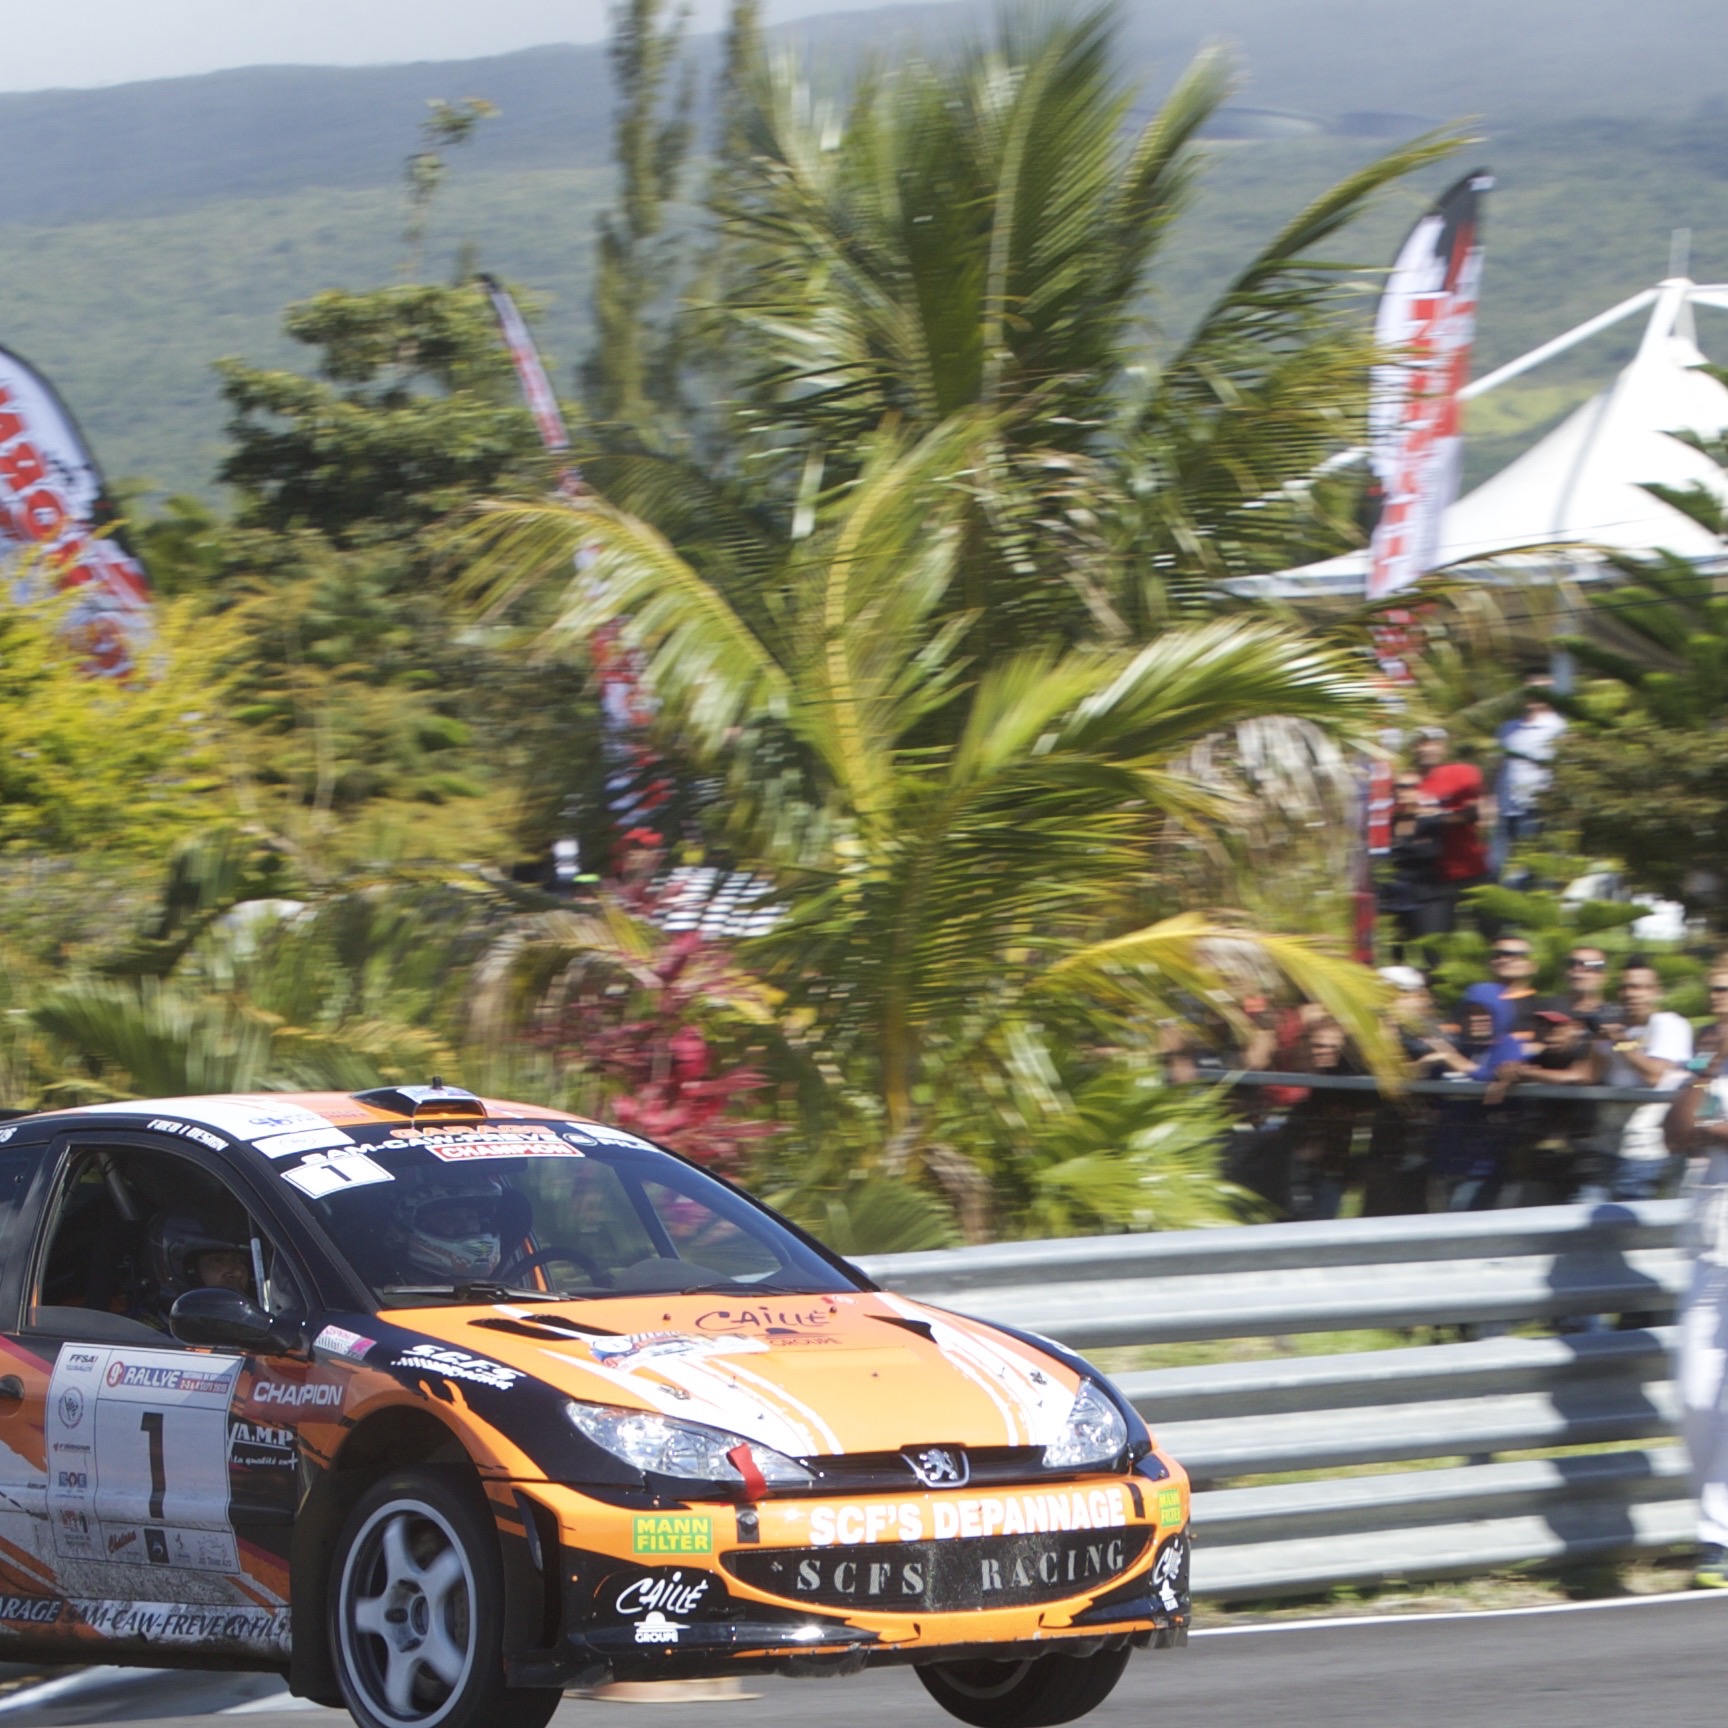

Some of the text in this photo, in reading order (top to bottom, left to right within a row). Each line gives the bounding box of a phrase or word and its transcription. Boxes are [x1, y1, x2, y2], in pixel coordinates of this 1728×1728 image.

[186, 1126, 229, 1151] DESIGN
[439, 1142, 573, 1158] CHAMPION
[321, 1165, 353, 1182] 1
[124, 1367, 181, 1388] RALLYE
[140, 1412, 166, 1519] 1
[933, 1488, 1126, 1540] DEPANNAGE
[637, 1519, 709, 1534] MANN
[637, 1535, 709, 1551] FILTER
[796, 1539, 1125, 1595] SCFS RACING
[635, 1631, 679, 1643] GROUPE
